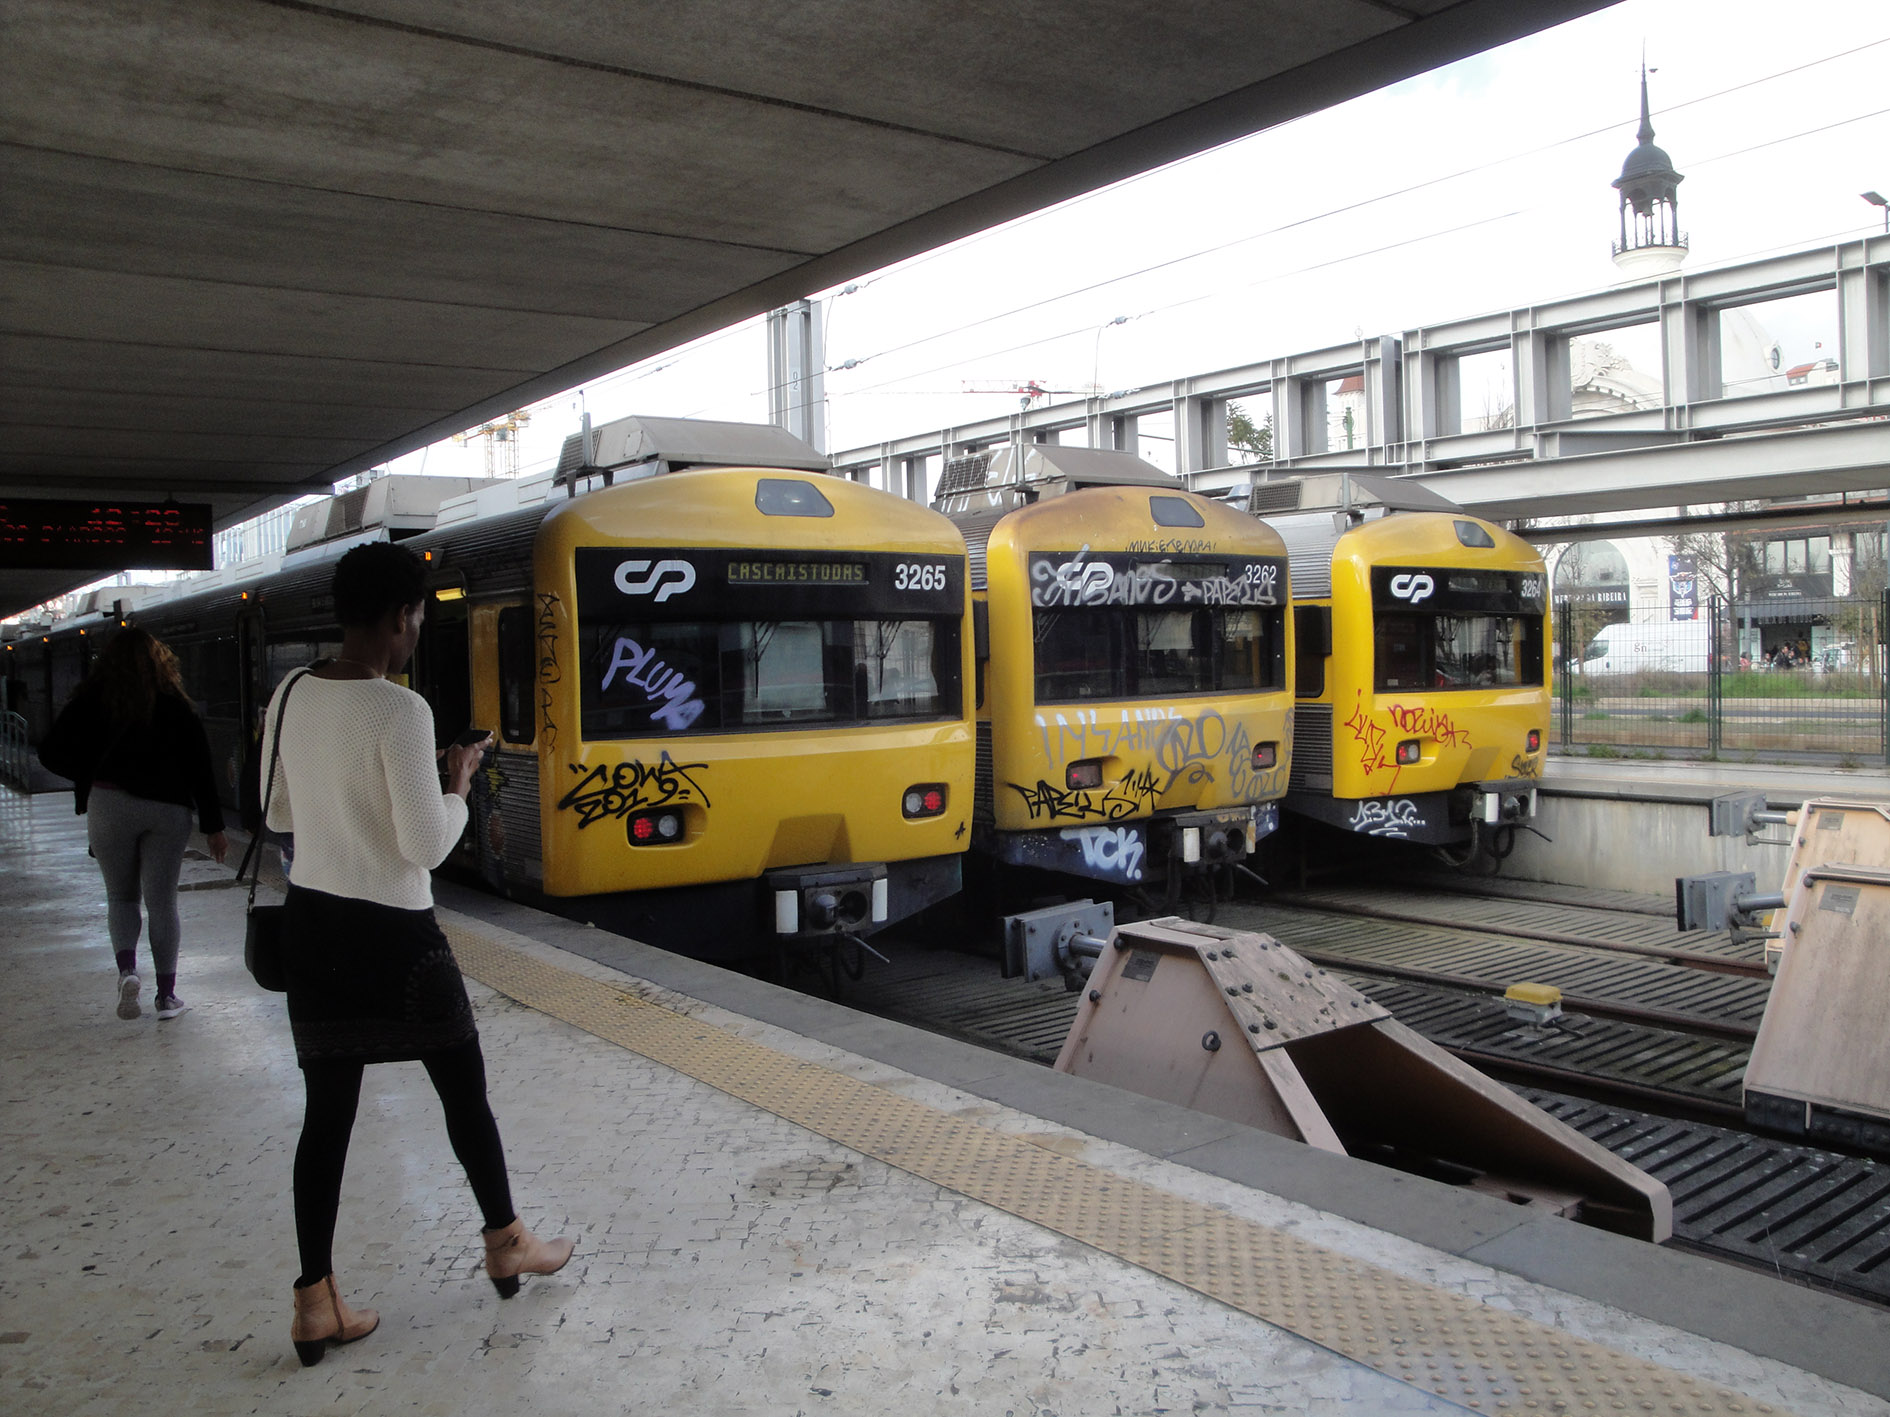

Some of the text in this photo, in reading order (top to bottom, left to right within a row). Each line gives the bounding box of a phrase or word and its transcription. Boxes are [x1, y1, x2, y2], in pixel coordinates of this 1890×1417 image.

[614, 559, 697, 603] CP
[895, 563, 946, 591] 3265
[1245, 564, 1278, 584] 3262
[1391, 574, 1434, 603] CP
[1521, 579, 1541, 598] 3264
[1597, 591, 1627, 602] RIBEIRA
